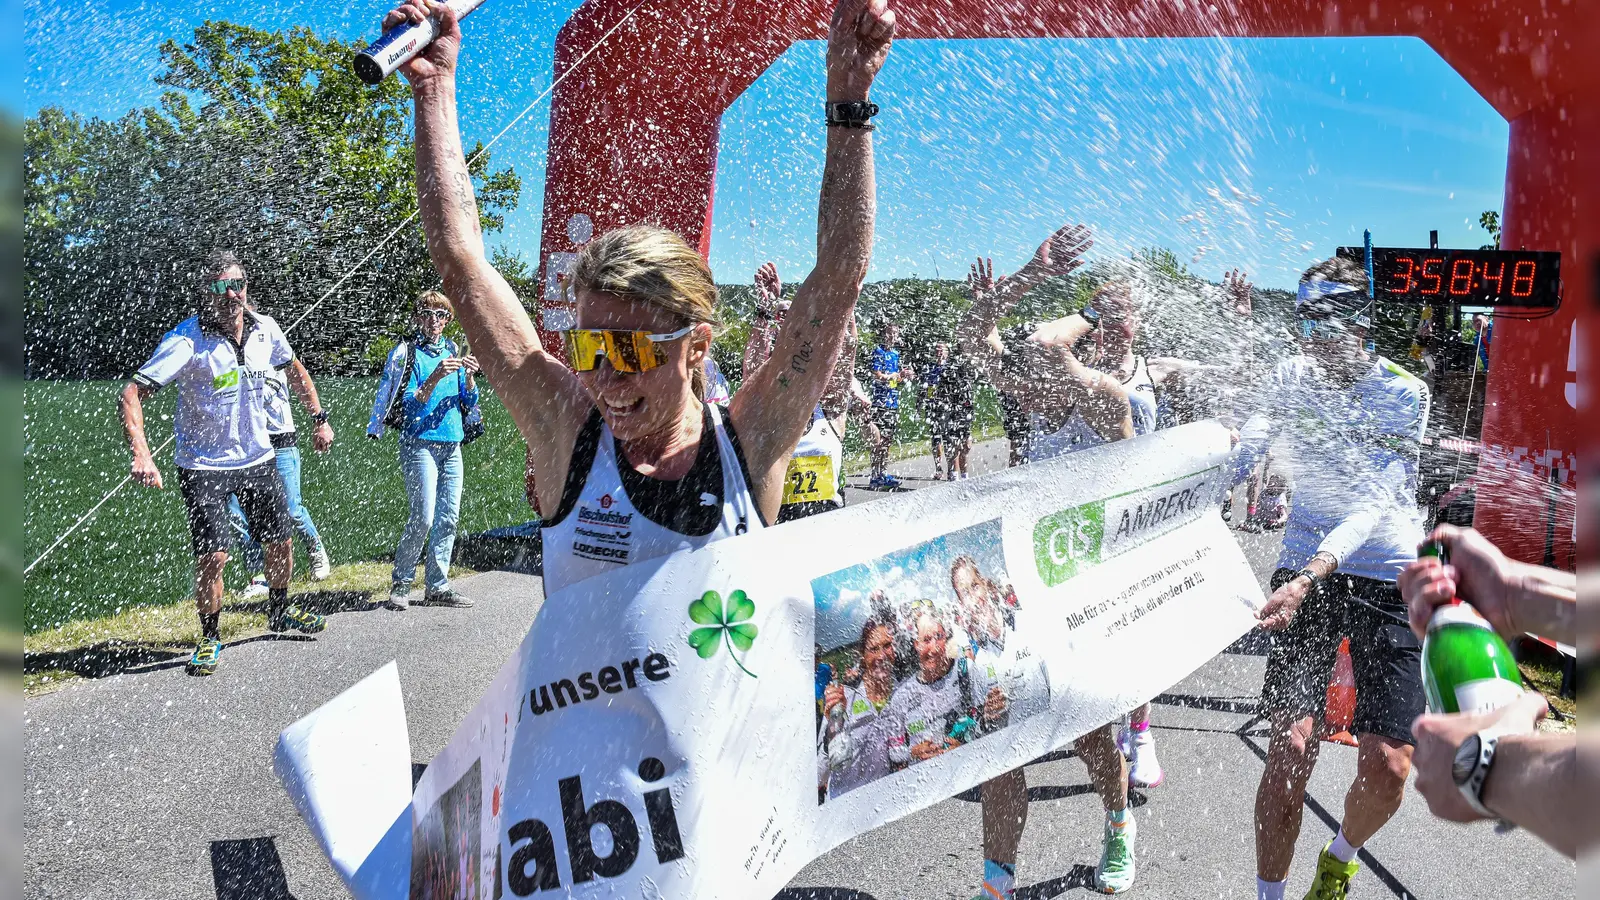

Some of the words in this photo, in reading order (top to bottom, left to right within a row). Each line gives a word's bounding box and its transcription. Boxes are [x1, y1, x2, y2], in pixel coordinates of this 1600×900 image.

[1391, 258, 1536, 297] 3:58:48
[792, 340, 814, 374] Max
[791, 470, 819, 495] 22
[578, 506, 634, 525] Bischofshof
[1113, 482, 1205, 542] AMBERG
[1065, 612, 1086, 631] Alle
[1083, 604, 1099, 621] für
[528, 650, 671, 717] unsere
